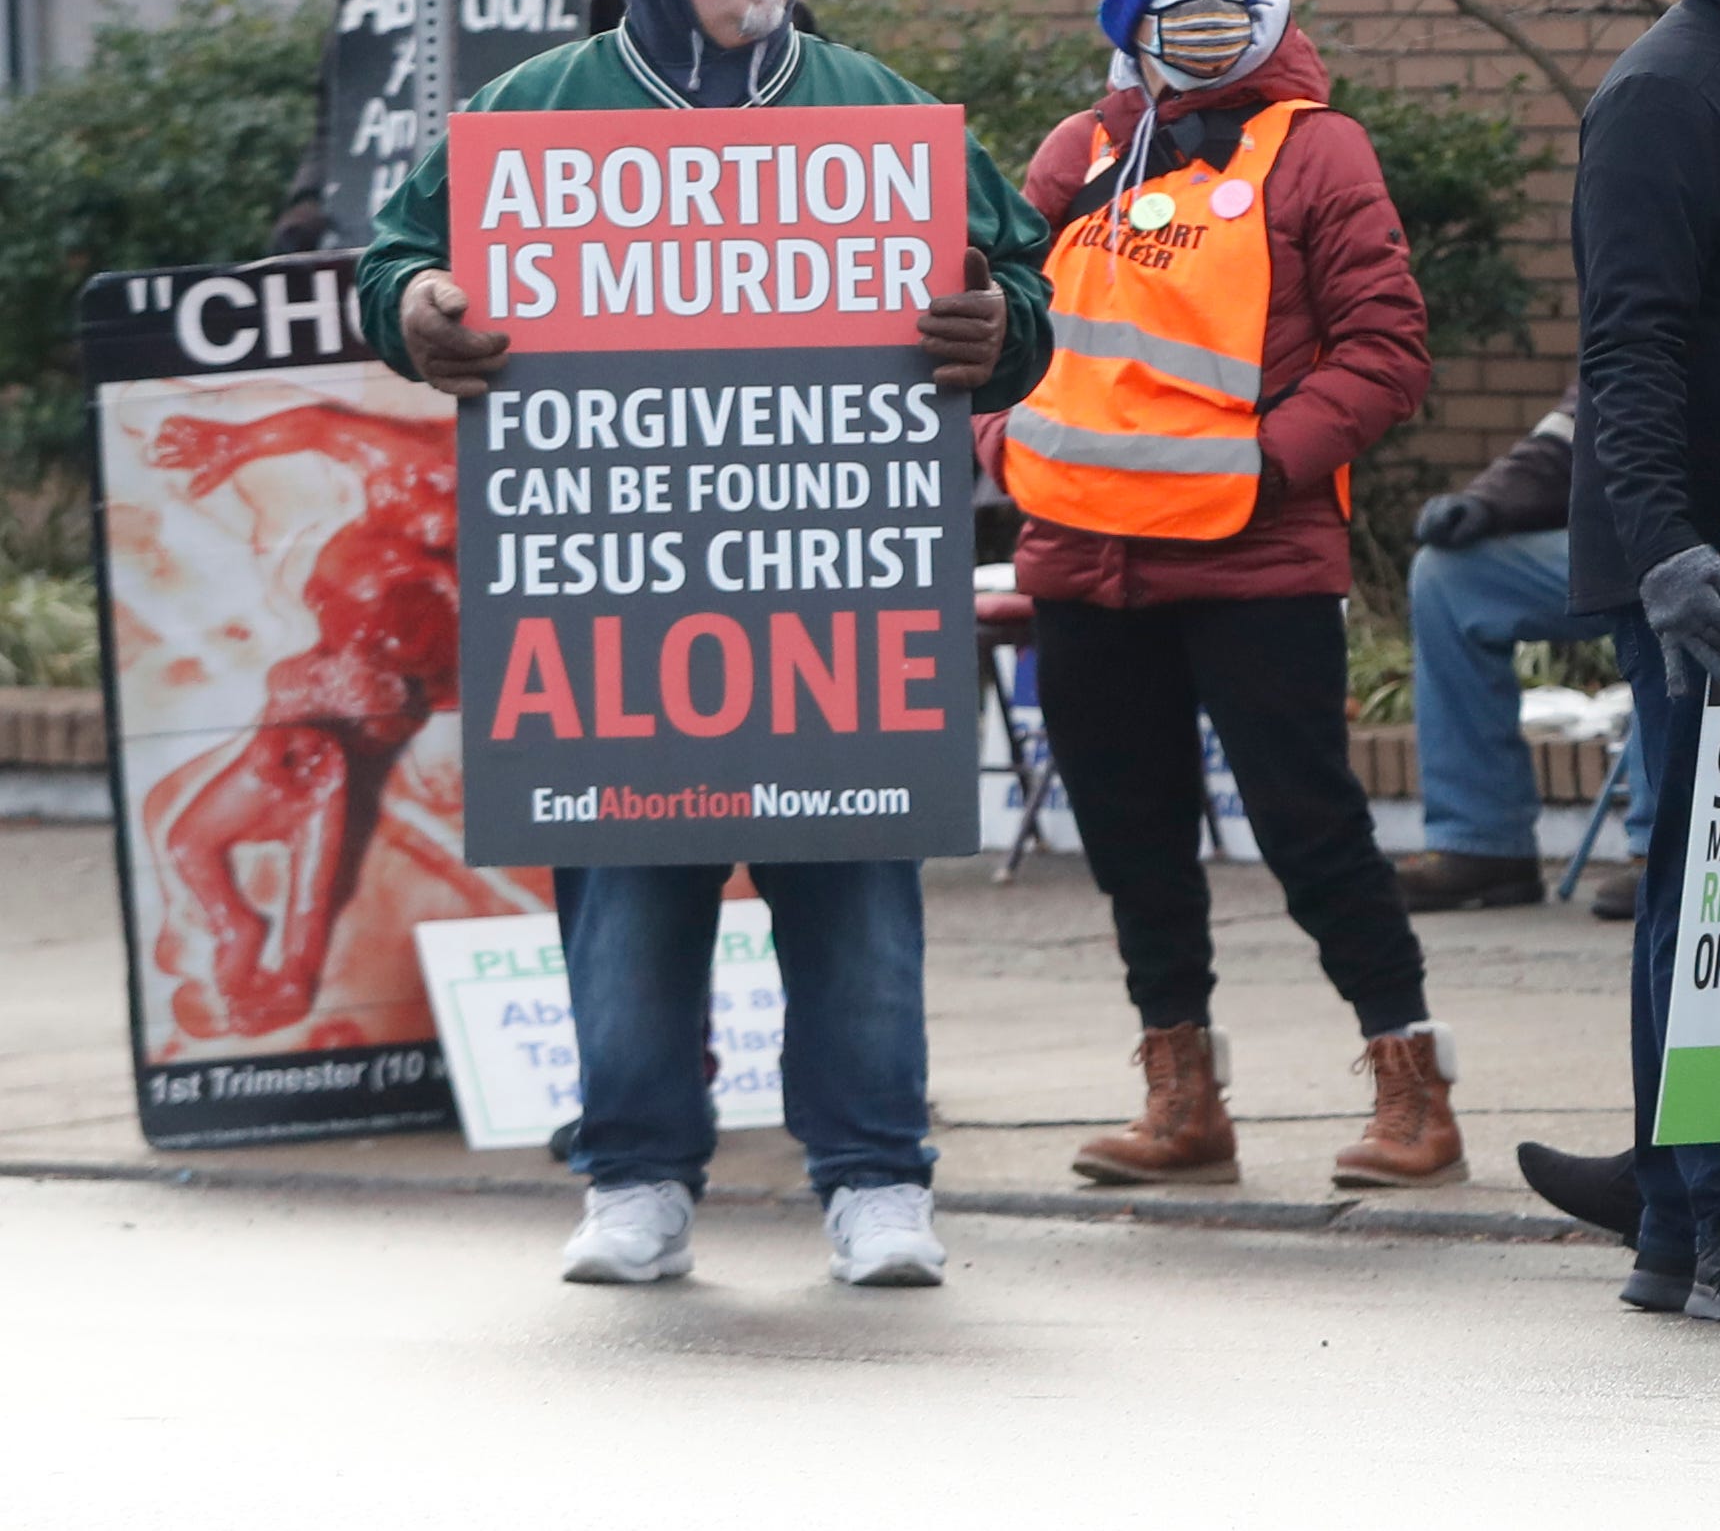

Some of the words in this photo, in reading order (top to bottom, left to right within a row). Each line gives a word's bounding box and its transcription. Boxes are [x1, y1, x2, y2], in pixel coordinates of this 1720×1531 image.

[481, 142, 931, 229] ABORTION
[489, 242, 557, 319] IS
[580, 237, 932, 316] MURDER
[489, 383, 940, 451] FORGIVENESS
[487, 466, 591, 516] CAN
[609, 465, 672, 514] BE
[689, 463, 870, 512] FOUND
[888, 461, 940, 508] IN
[488, 530, 686, 596] JESUS
[706, 526, 943, 592] CHRIST
[490, 609, 945, 740] ALONE
[532, 783, 910, 822] EndAbortionNow.com
[473, 945, 568, 977] PLE
[150, 1072, 200, 1106] 1st
[208, 1060, 368, 1100] Trimester
